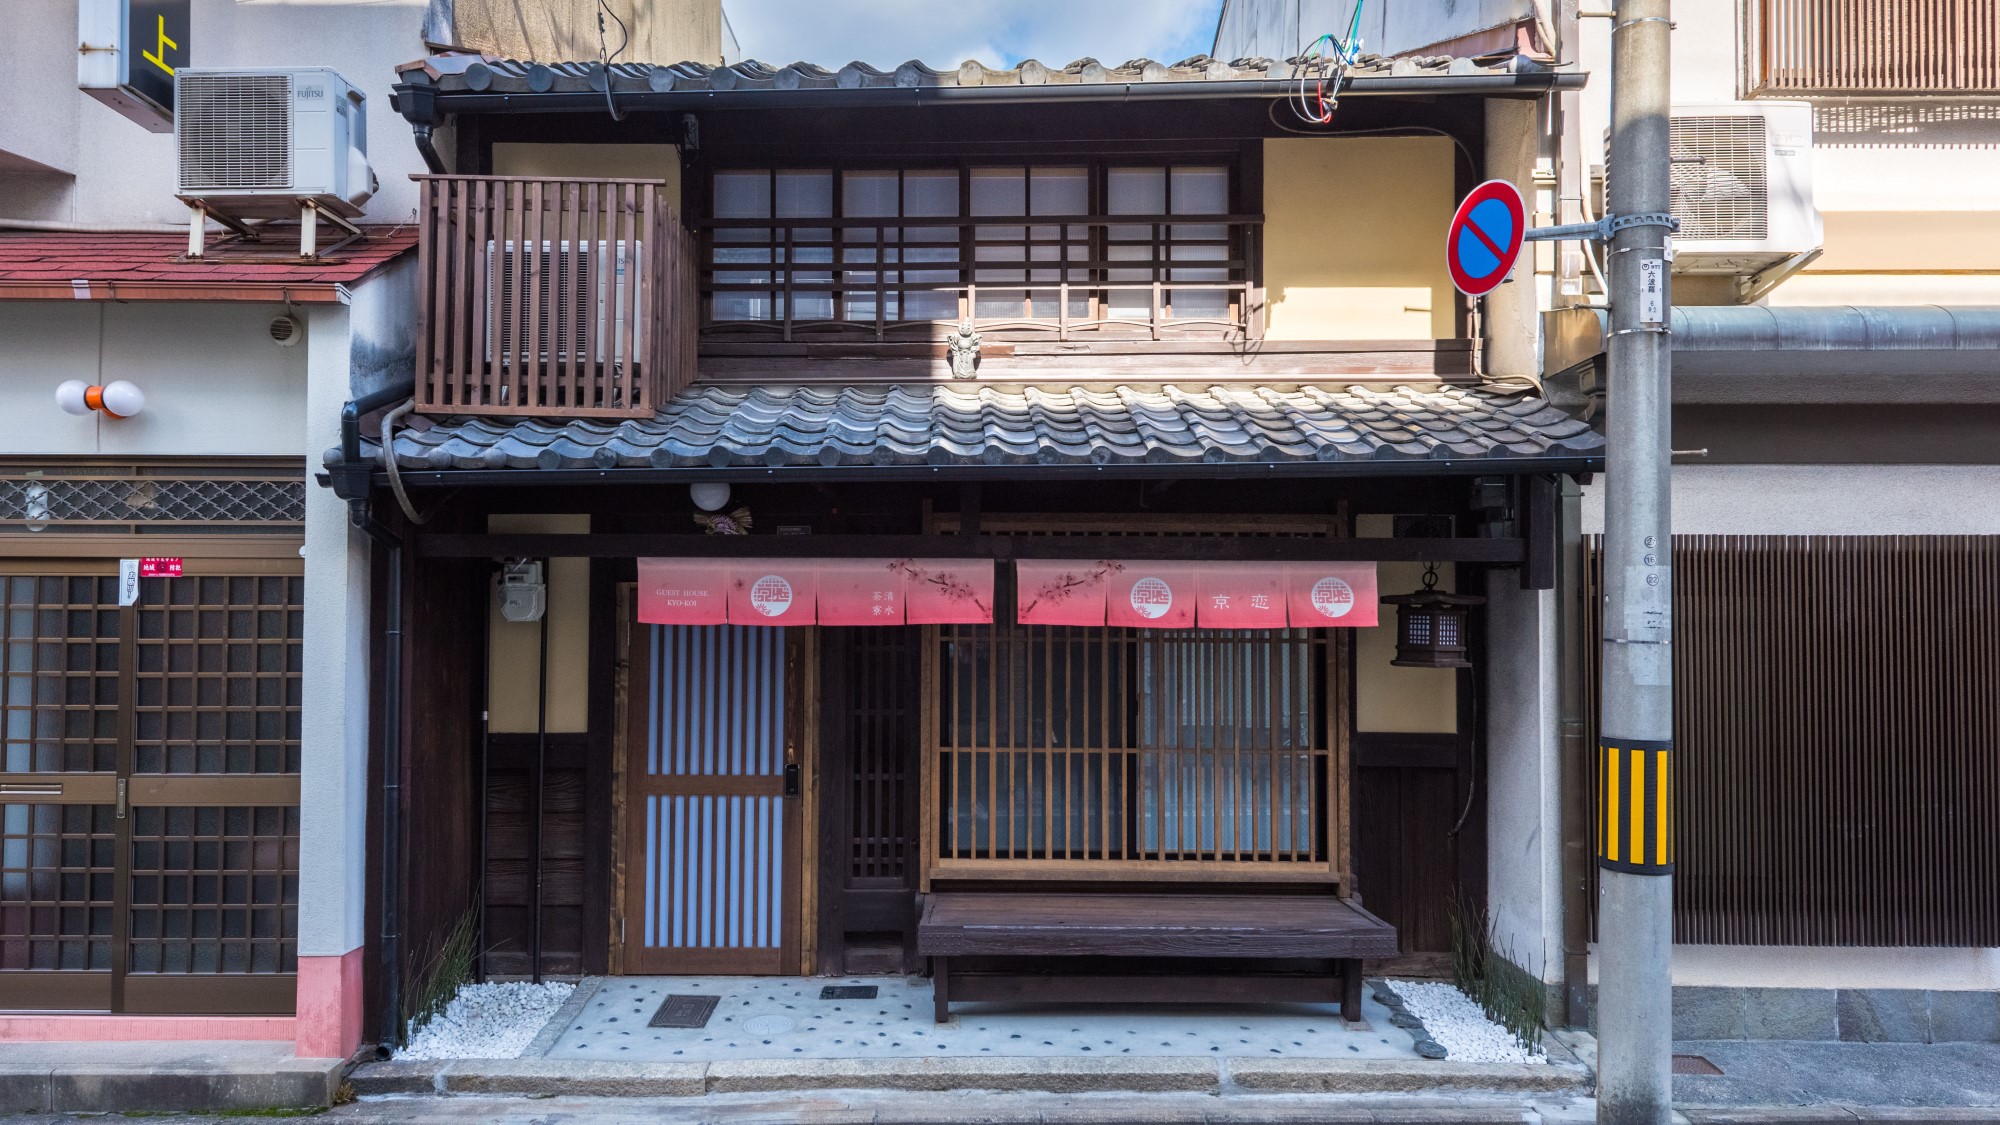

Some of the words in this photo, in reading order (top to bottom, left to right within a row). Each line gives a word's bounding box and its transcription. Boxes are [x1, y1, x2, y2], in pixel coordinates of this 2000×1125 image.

[297, 87, 324, 98] FUJITSU
[1648, 270, 1656, 293] 六波羅
[667, 599, 697, 607] KYO-KOI
[872, 591, 882, 616] 茶寮
[884, 591, 895, 616] 清水
